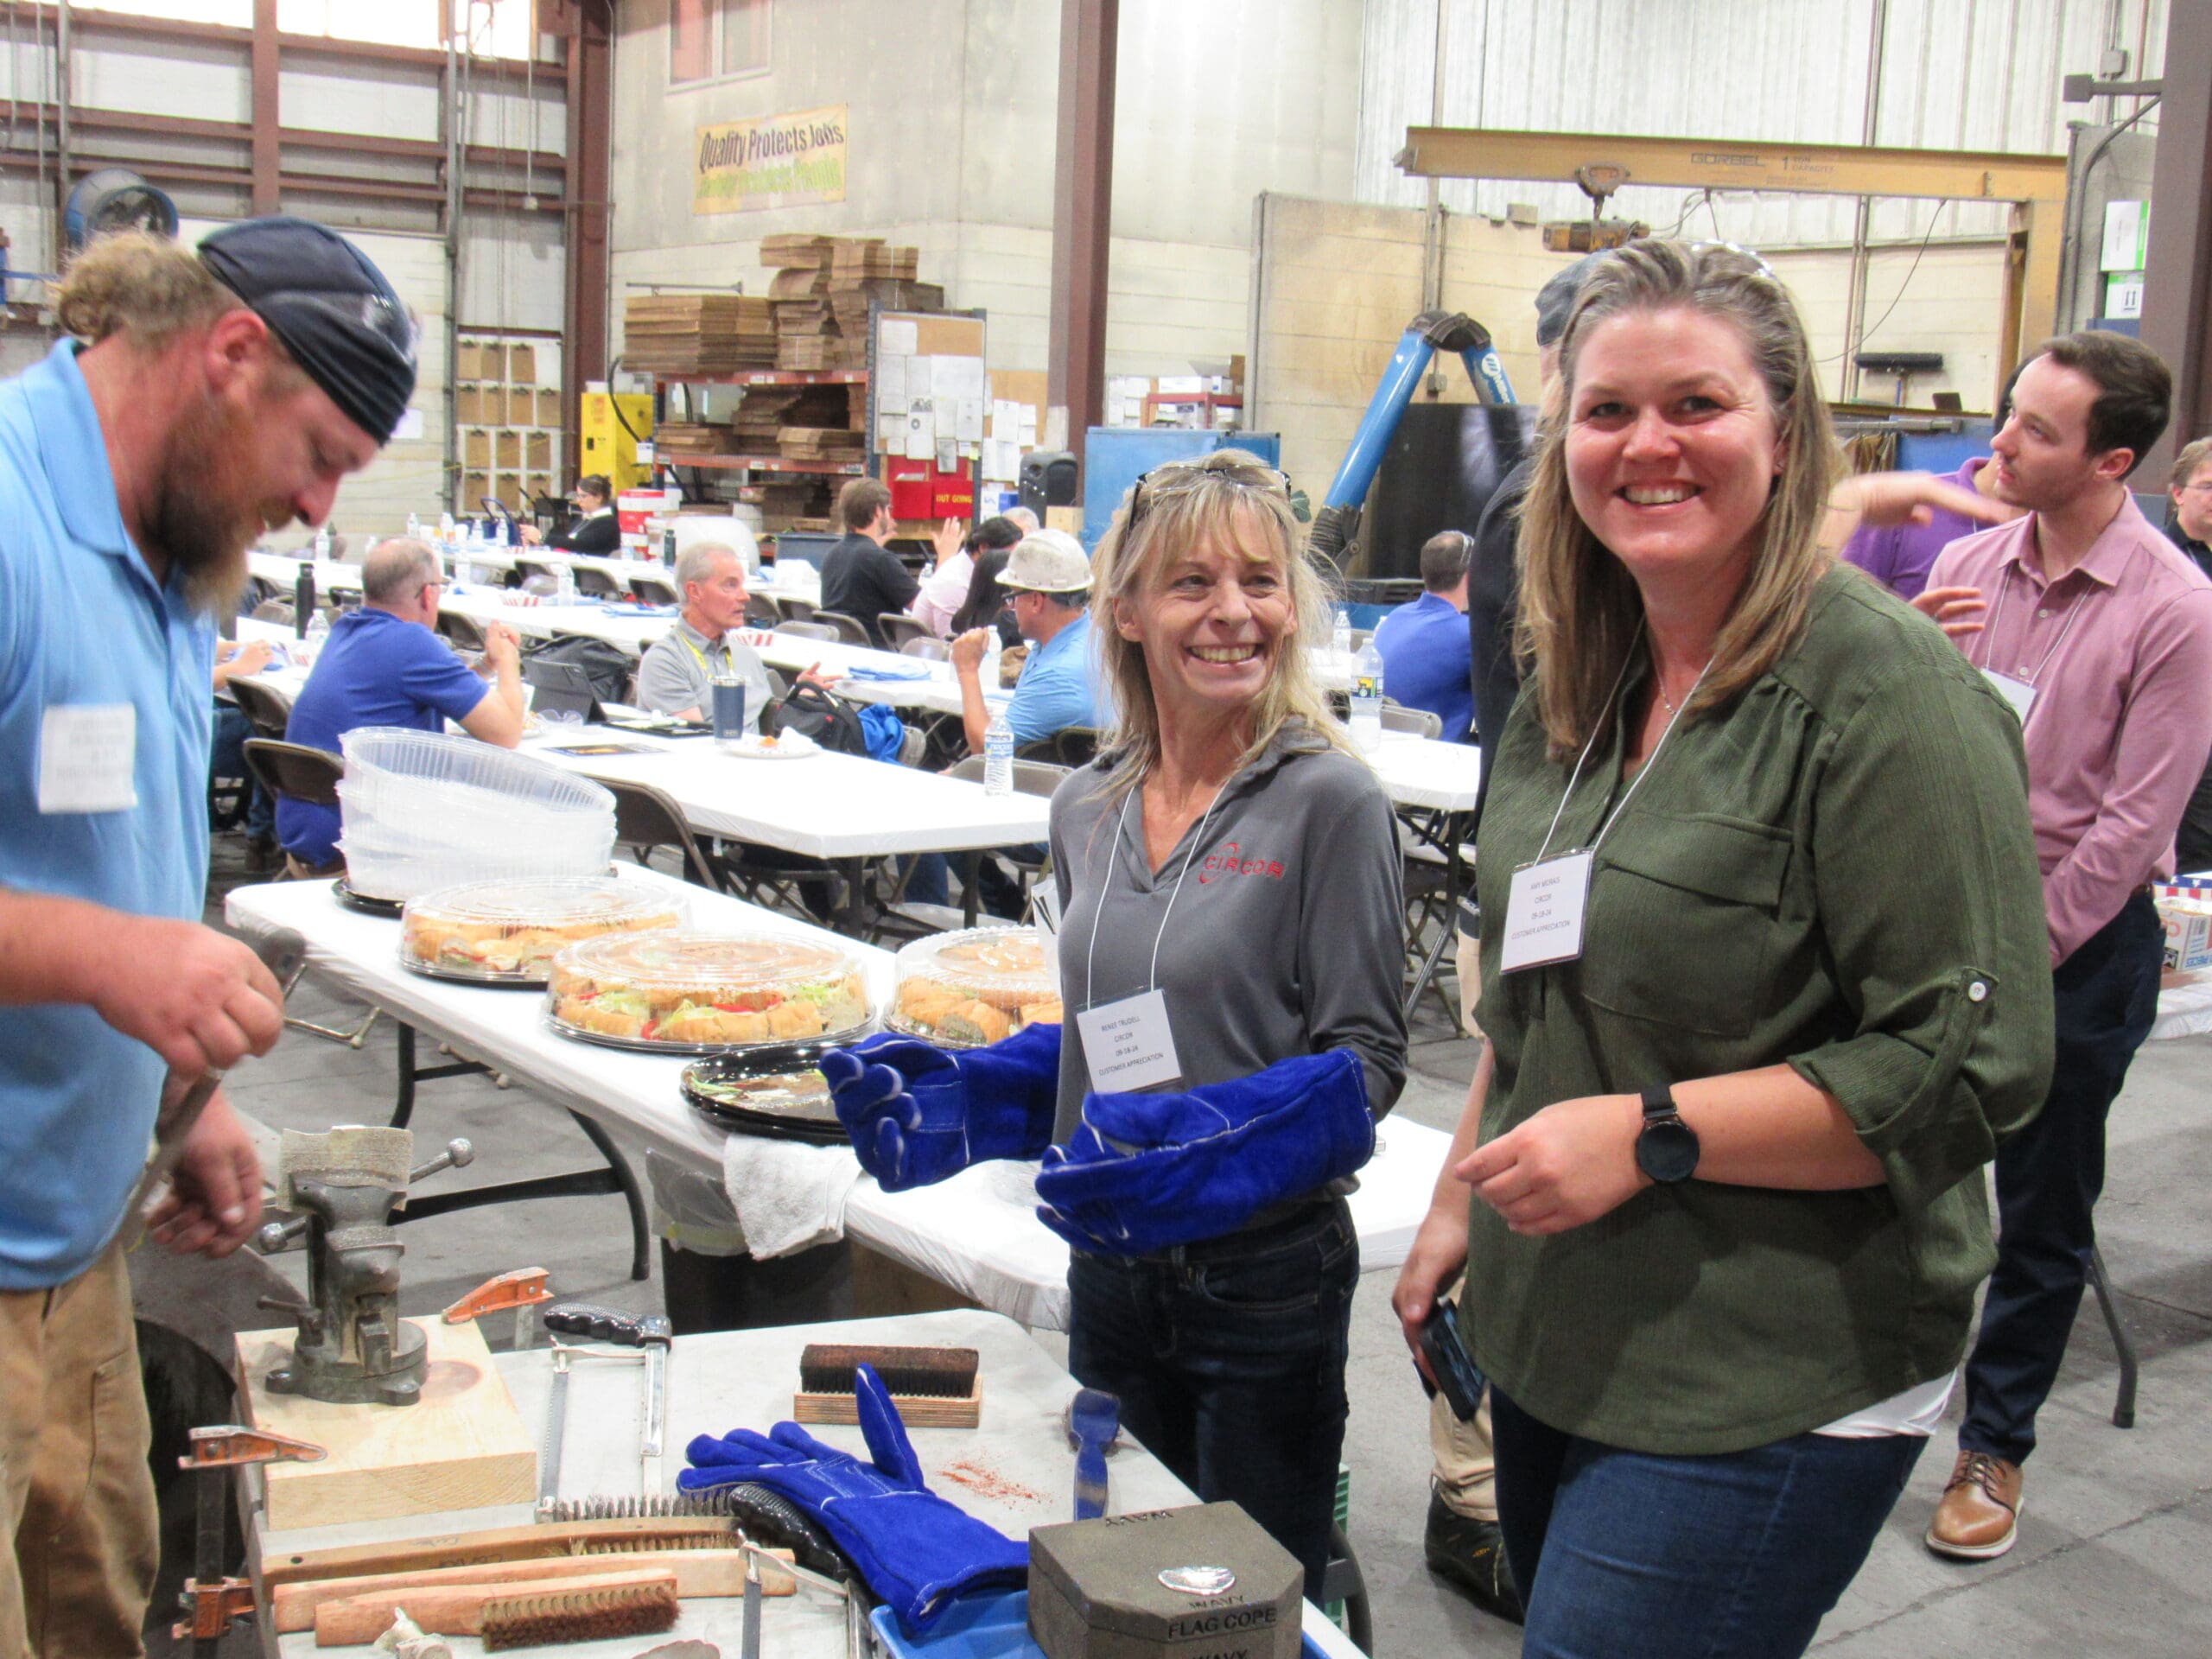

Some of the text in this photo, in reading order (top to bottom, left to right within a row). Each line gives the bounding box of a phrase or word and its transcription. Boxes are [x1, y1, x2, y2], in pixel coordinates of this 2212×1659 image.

[699, 123, 845, 173] Quality Protects Jobs
[1690, 152, 1765, 168] GORBEL
[1782, 156, 1789, 171] 1
[1204, 855, 1286, 880] CIRCOR
[1098, 1052, 1164, 1076] CUSTOMER APPRECIATION
[1168, 1606, 1277, 1640] FLAG COPE
